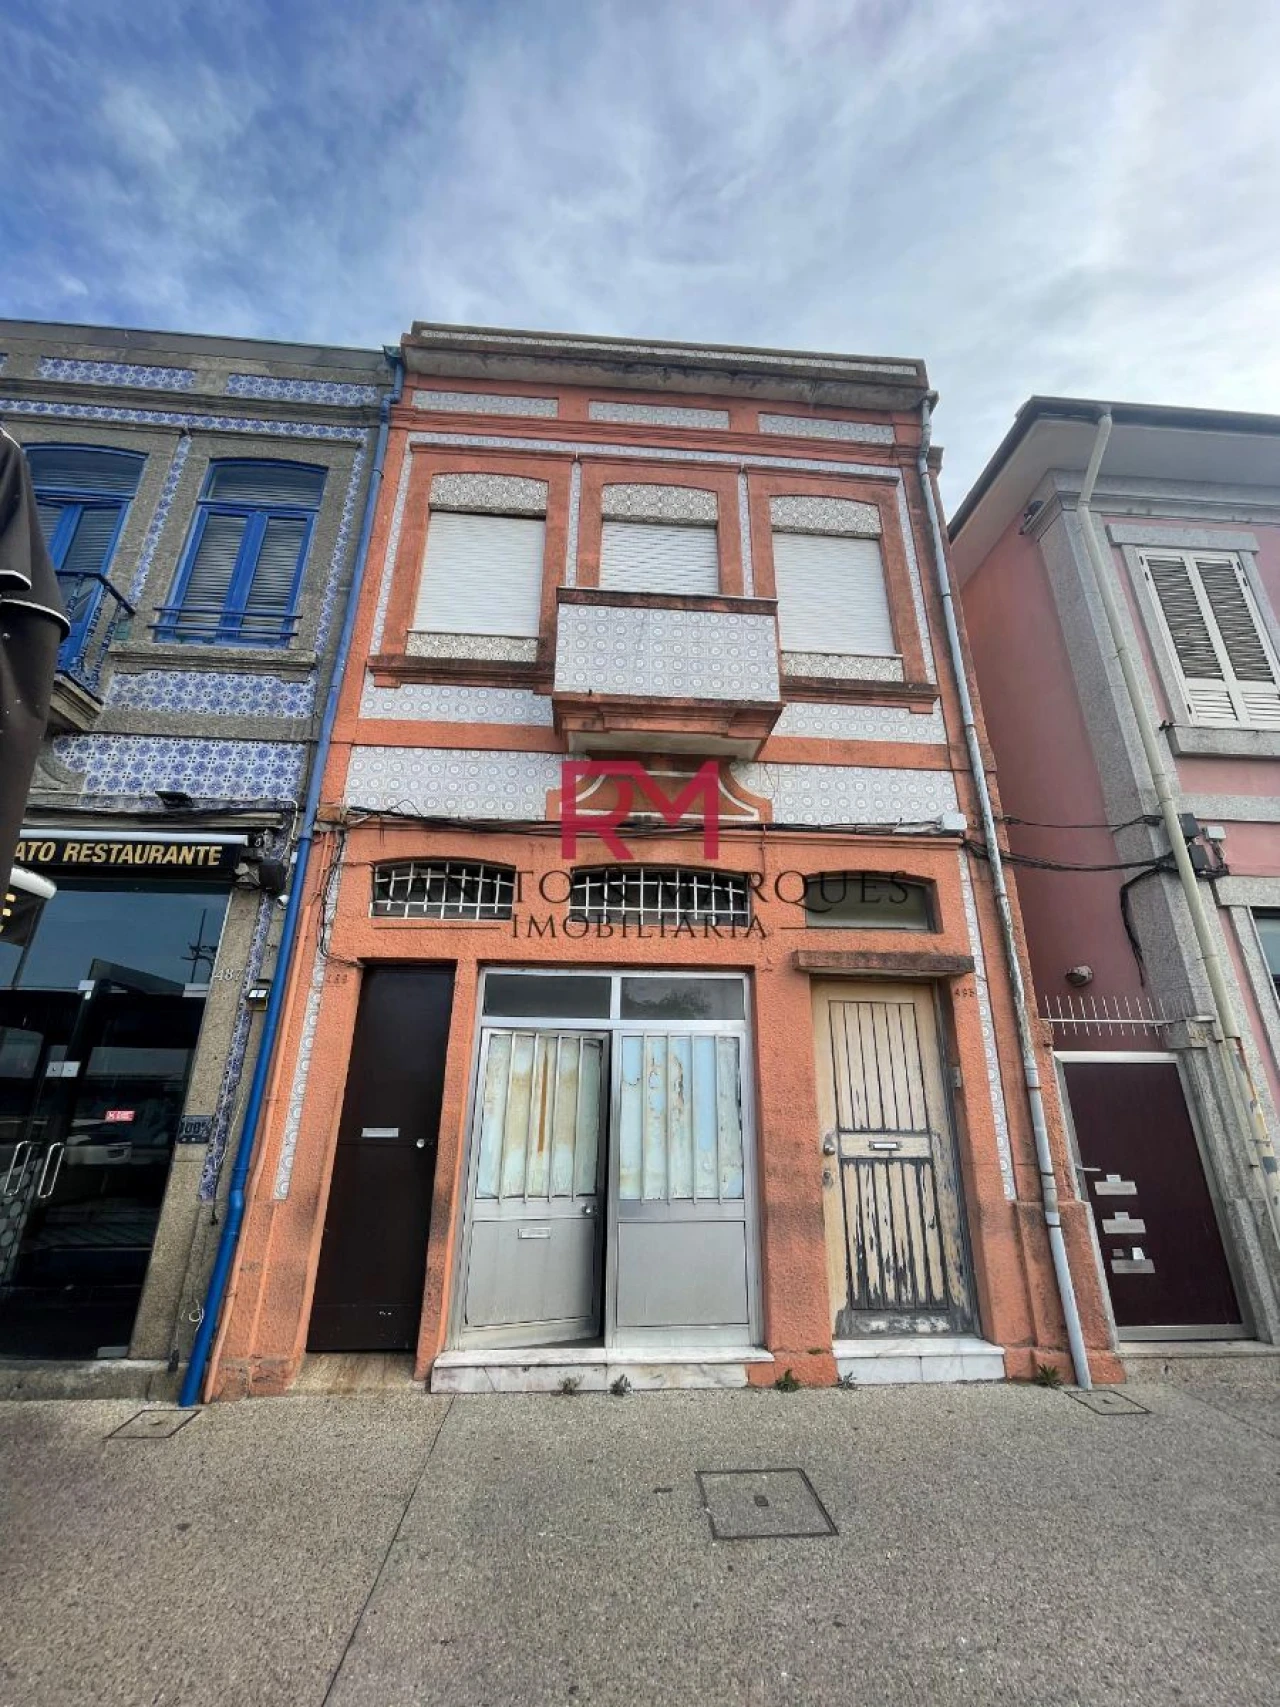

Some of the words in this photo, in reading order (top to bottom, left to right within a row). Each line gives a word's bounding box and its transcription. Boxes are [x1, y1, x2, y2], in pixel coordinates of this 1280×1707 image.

[14, 841, 56, 862] ATO
[62, 842, 222, 866] RESTAURANTE
[213, 968, 243, 981] 487
